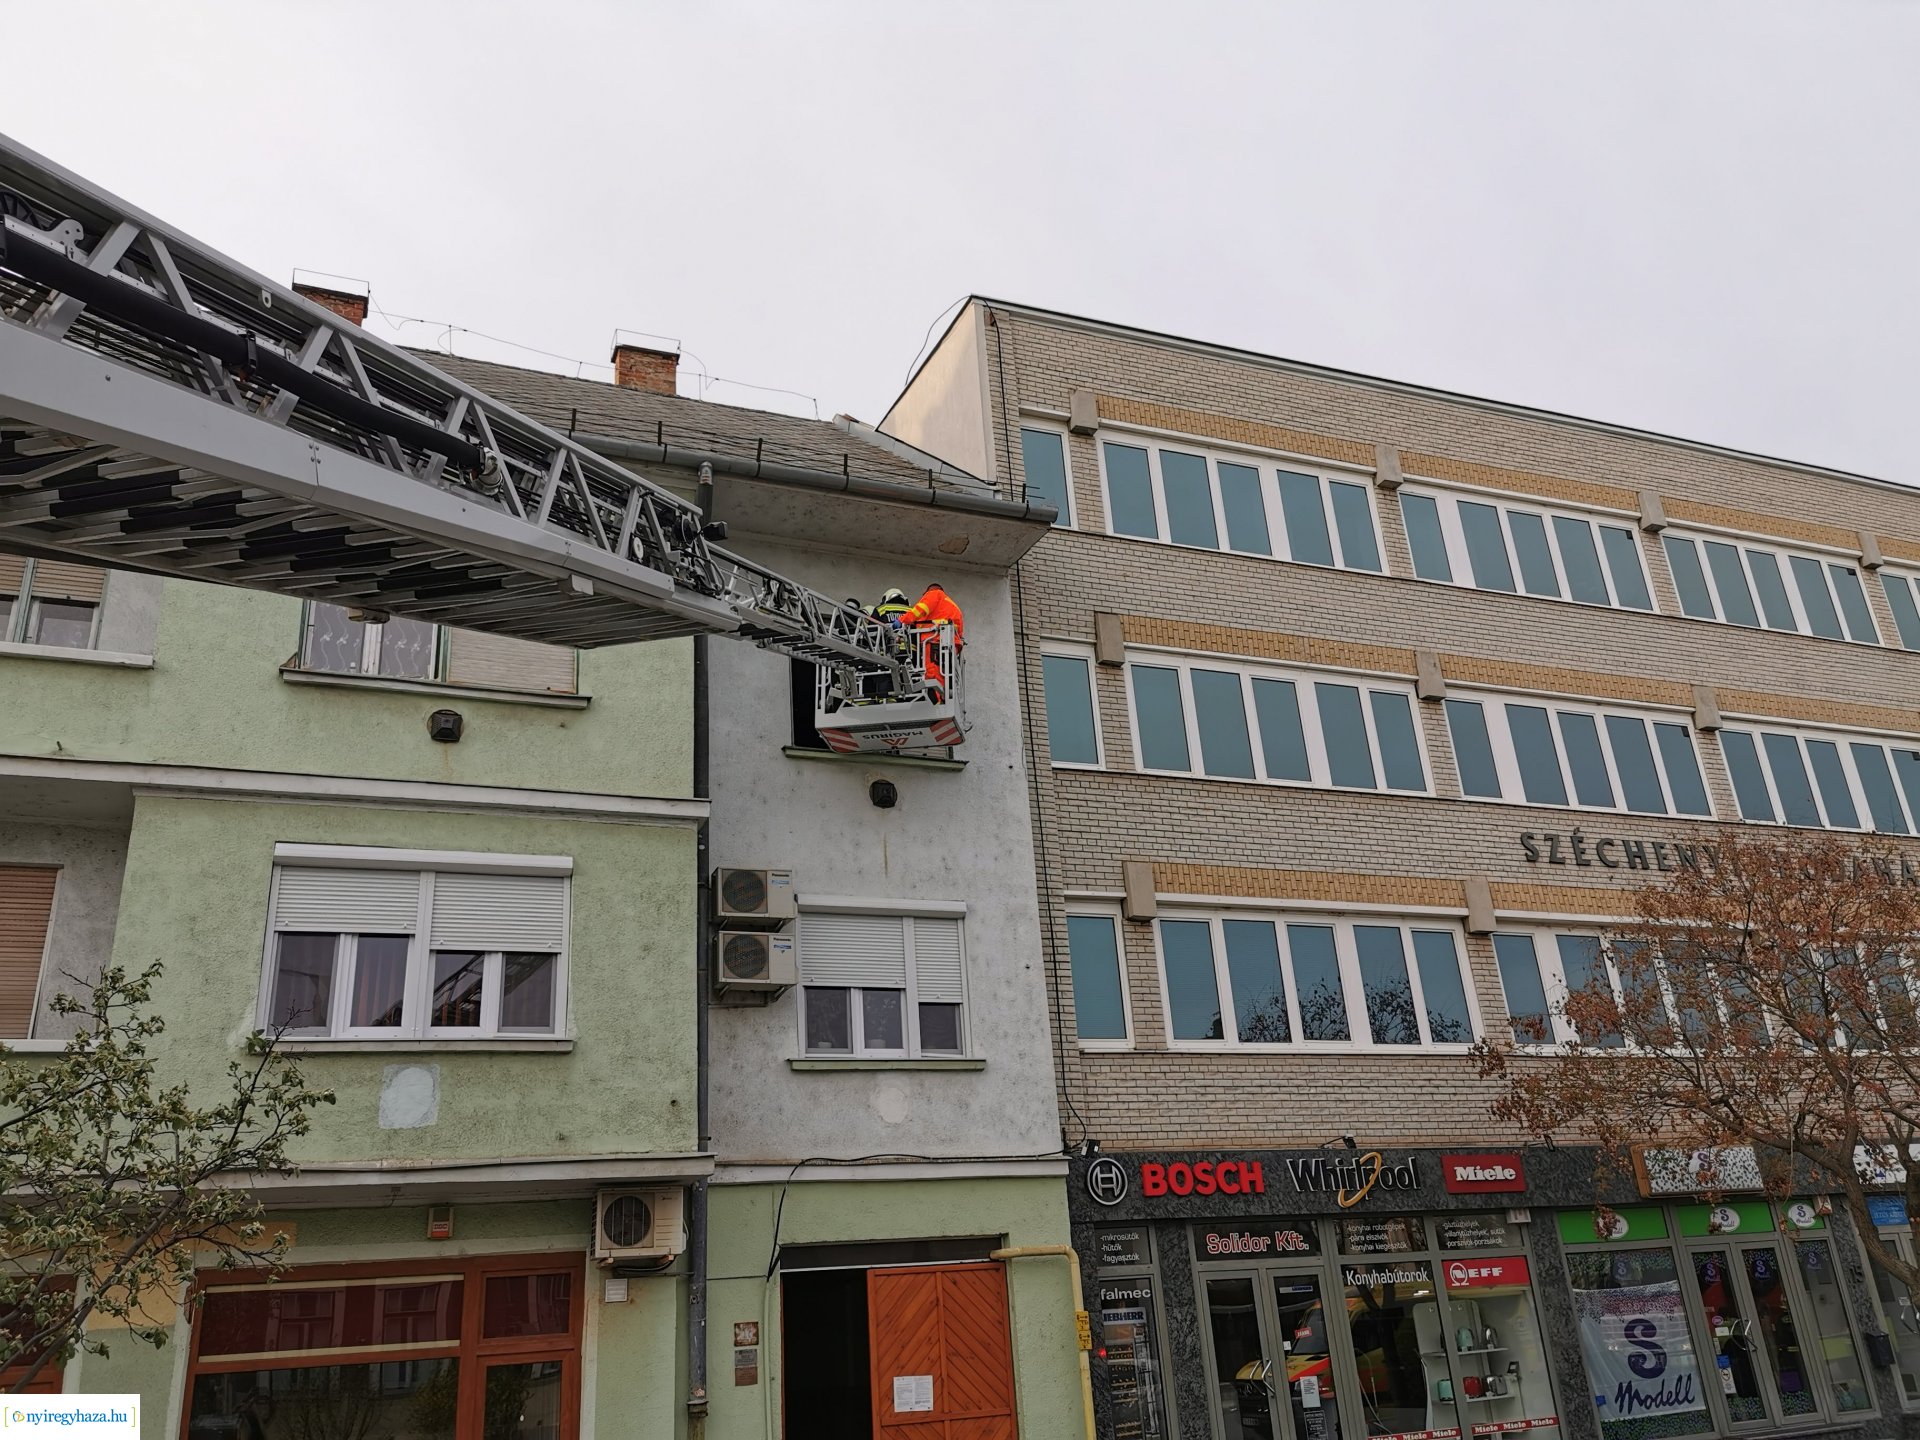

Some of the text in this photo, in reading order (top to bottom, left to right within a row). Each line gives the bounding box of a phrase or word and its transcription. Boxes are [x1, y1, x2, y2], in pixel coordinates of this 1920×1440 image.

[862, 731, 923, 740] MAGIRUS
[1140, 1161, 1265, 1197] BOSCH
[1286, 1157, 1421, 1201] Whirlpool
[1454, 1165, 1517, 1182] Miele
[1205, 1230, 1310, 1254] Solidor Kft.
[1346, 1266, 1430, 1288] Konyhabútorok
[1450, 1265, 1503, 1282] NEFF
[1100, 1287, 1151, 1300] falmec
[1104, 1312, 1143, 1321] IEBHERR
[1624, 1318, 1667, 1379] S
[1615, 1373, 1695, 1414] Modell
[1432, 1429, 1456, 1438] Miele
[1475, 1418, 1554, 1433] Miele Miele Miele
